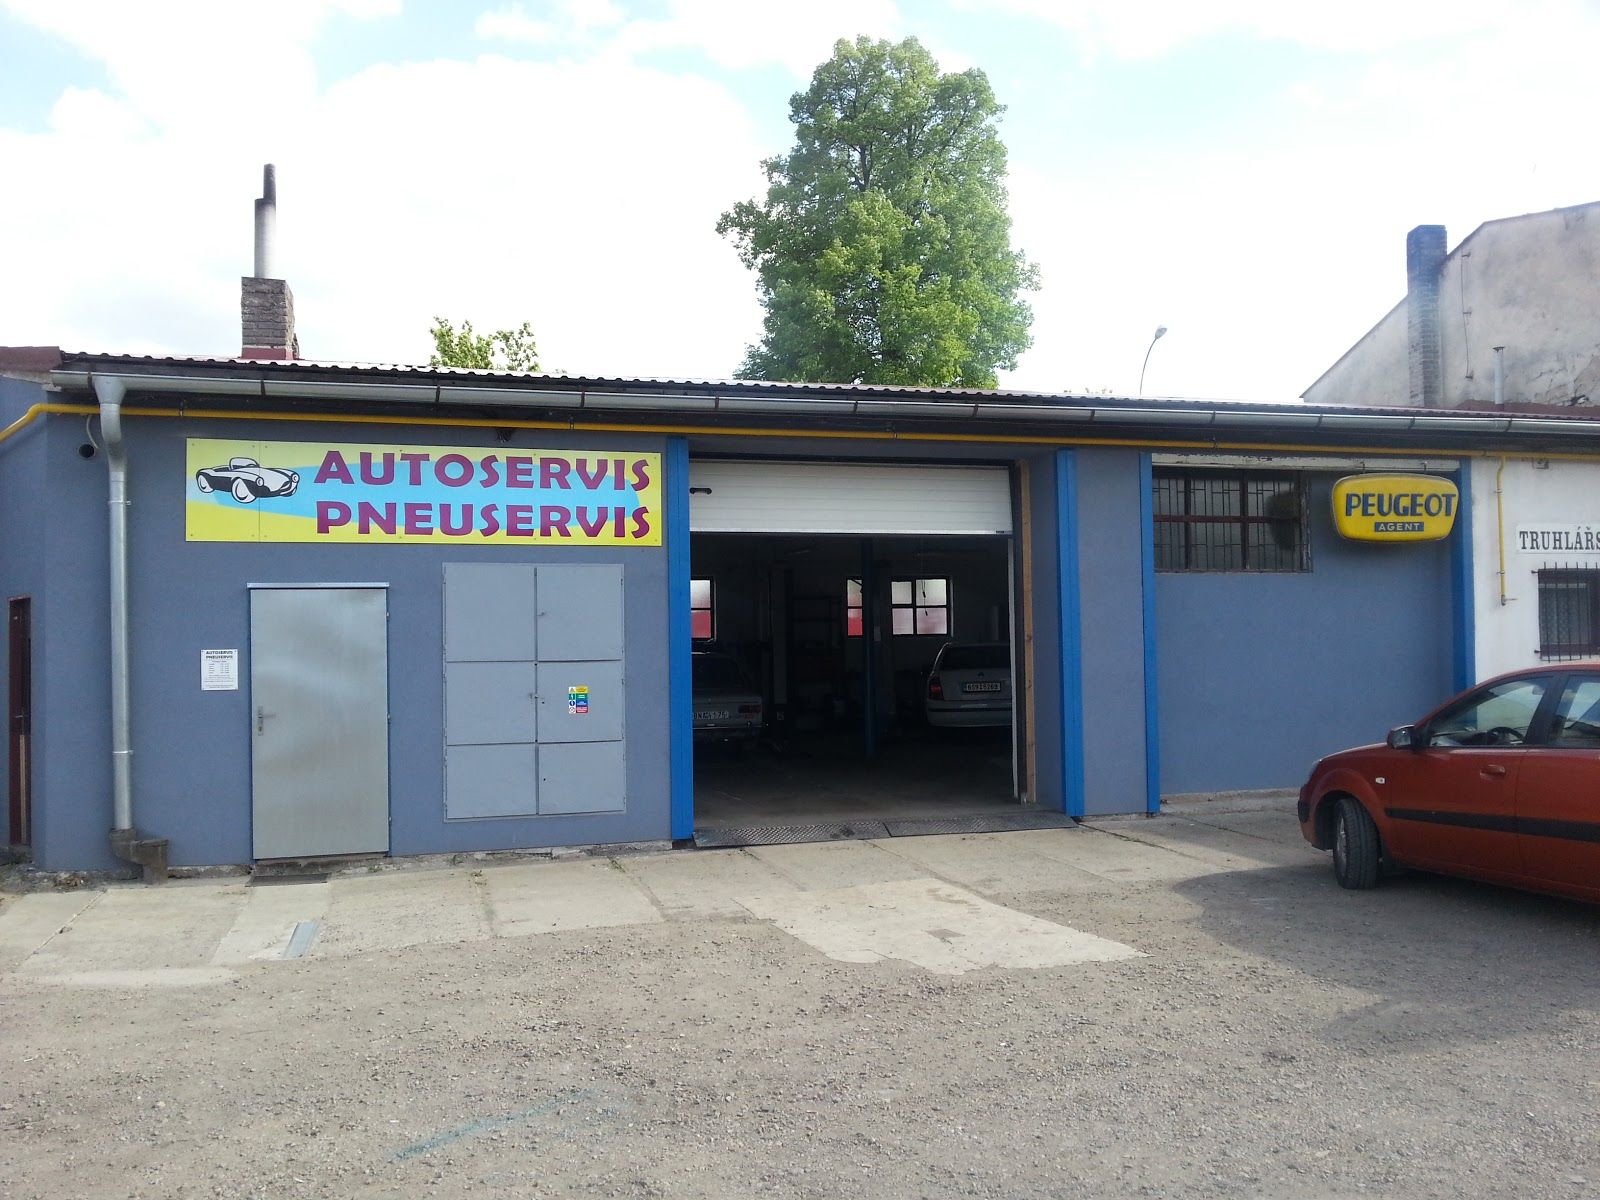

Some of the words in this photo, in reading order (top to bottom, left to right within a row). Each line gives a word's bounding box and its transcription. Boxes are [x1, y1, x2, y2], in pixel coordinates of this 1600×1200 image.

[314, 450, 650, 492] AUTOSERVIS
[316, 500, 650, 539] PNEUSERVIS
[1345, 493, 1456, 517] PEUGEOT
[1378, 522, 1421, 531] AGENT
